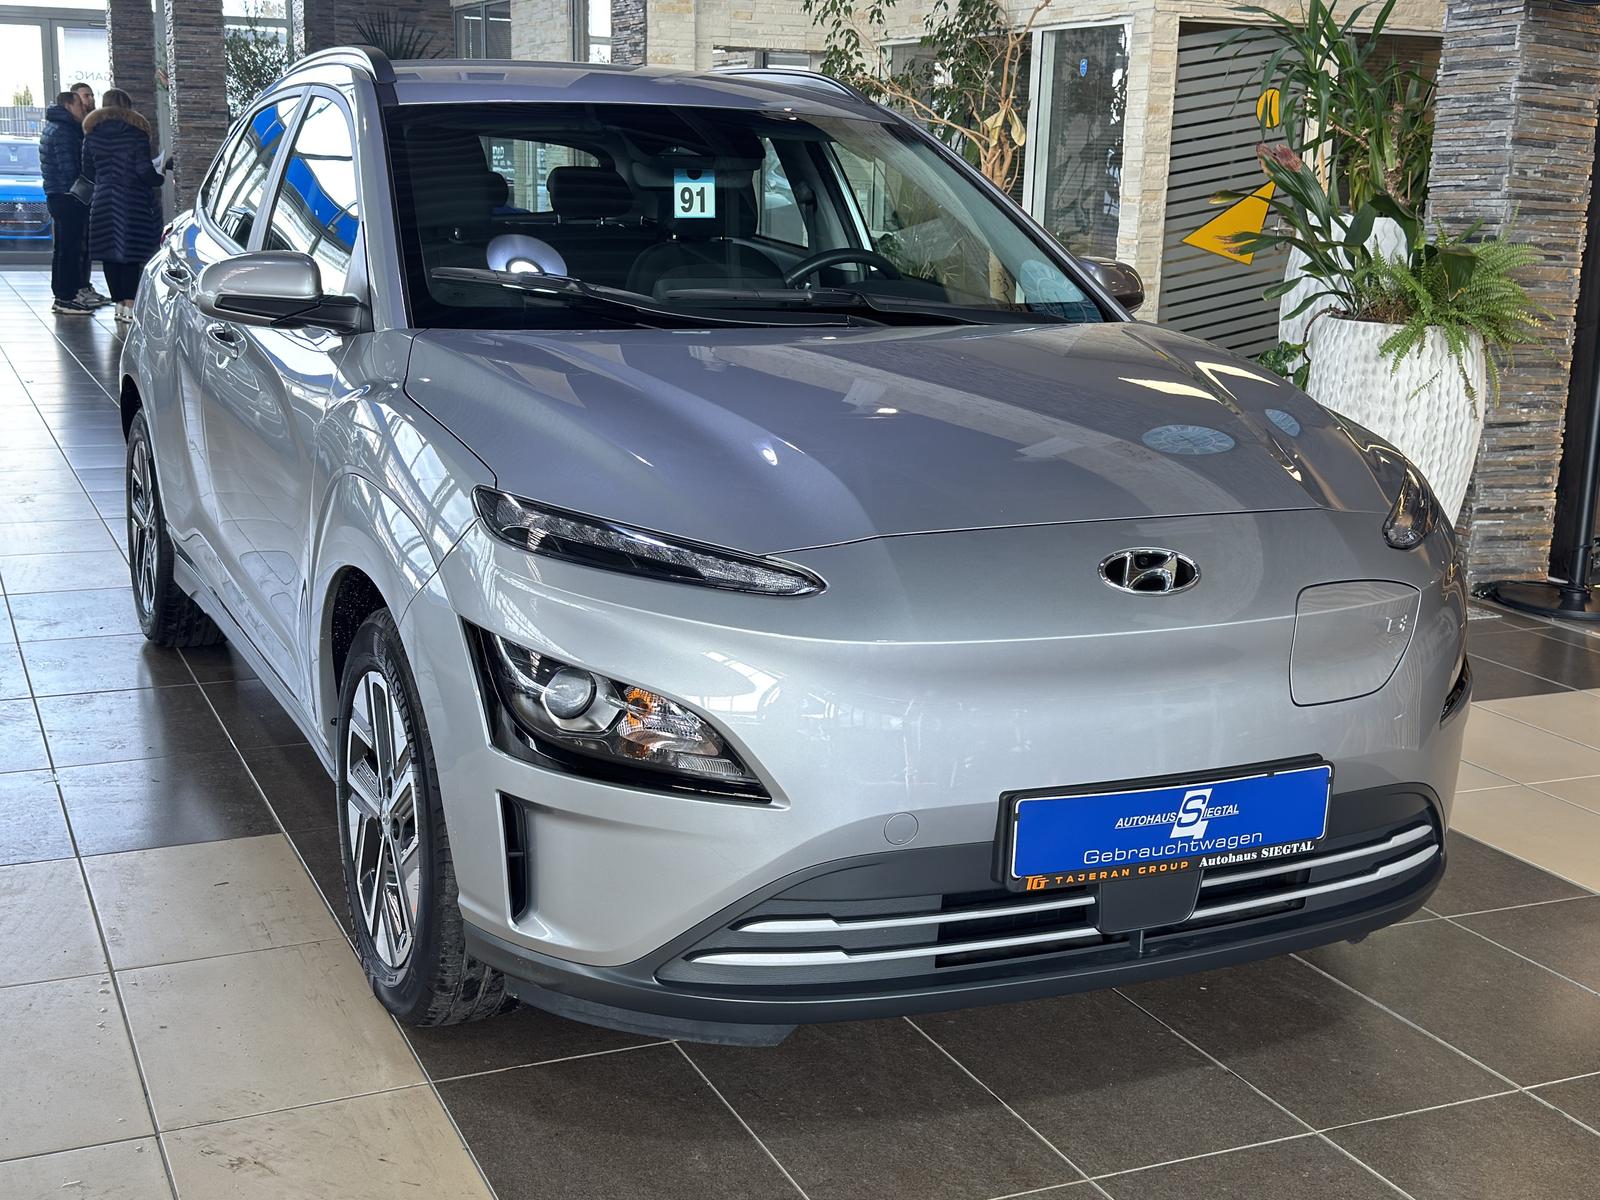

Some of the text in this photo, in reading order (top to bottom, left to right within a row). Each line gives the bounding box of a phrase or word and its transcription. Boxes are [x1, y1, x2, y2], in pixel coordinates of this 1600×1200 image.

[680, 186, 706, 213] 91
[387, 658, 417, 759] MICHELIN
[1115, 812, 1178, 828] AUTOHAUS
[1083, 832, 1263, 865] Gebrauchtwagen
[1199, 840, 1315, 868] Autohaus SIEGTAL
[1055, 867, 1131, 885] TAJERAN
[1138, 860, 1190, 875] GROUP
